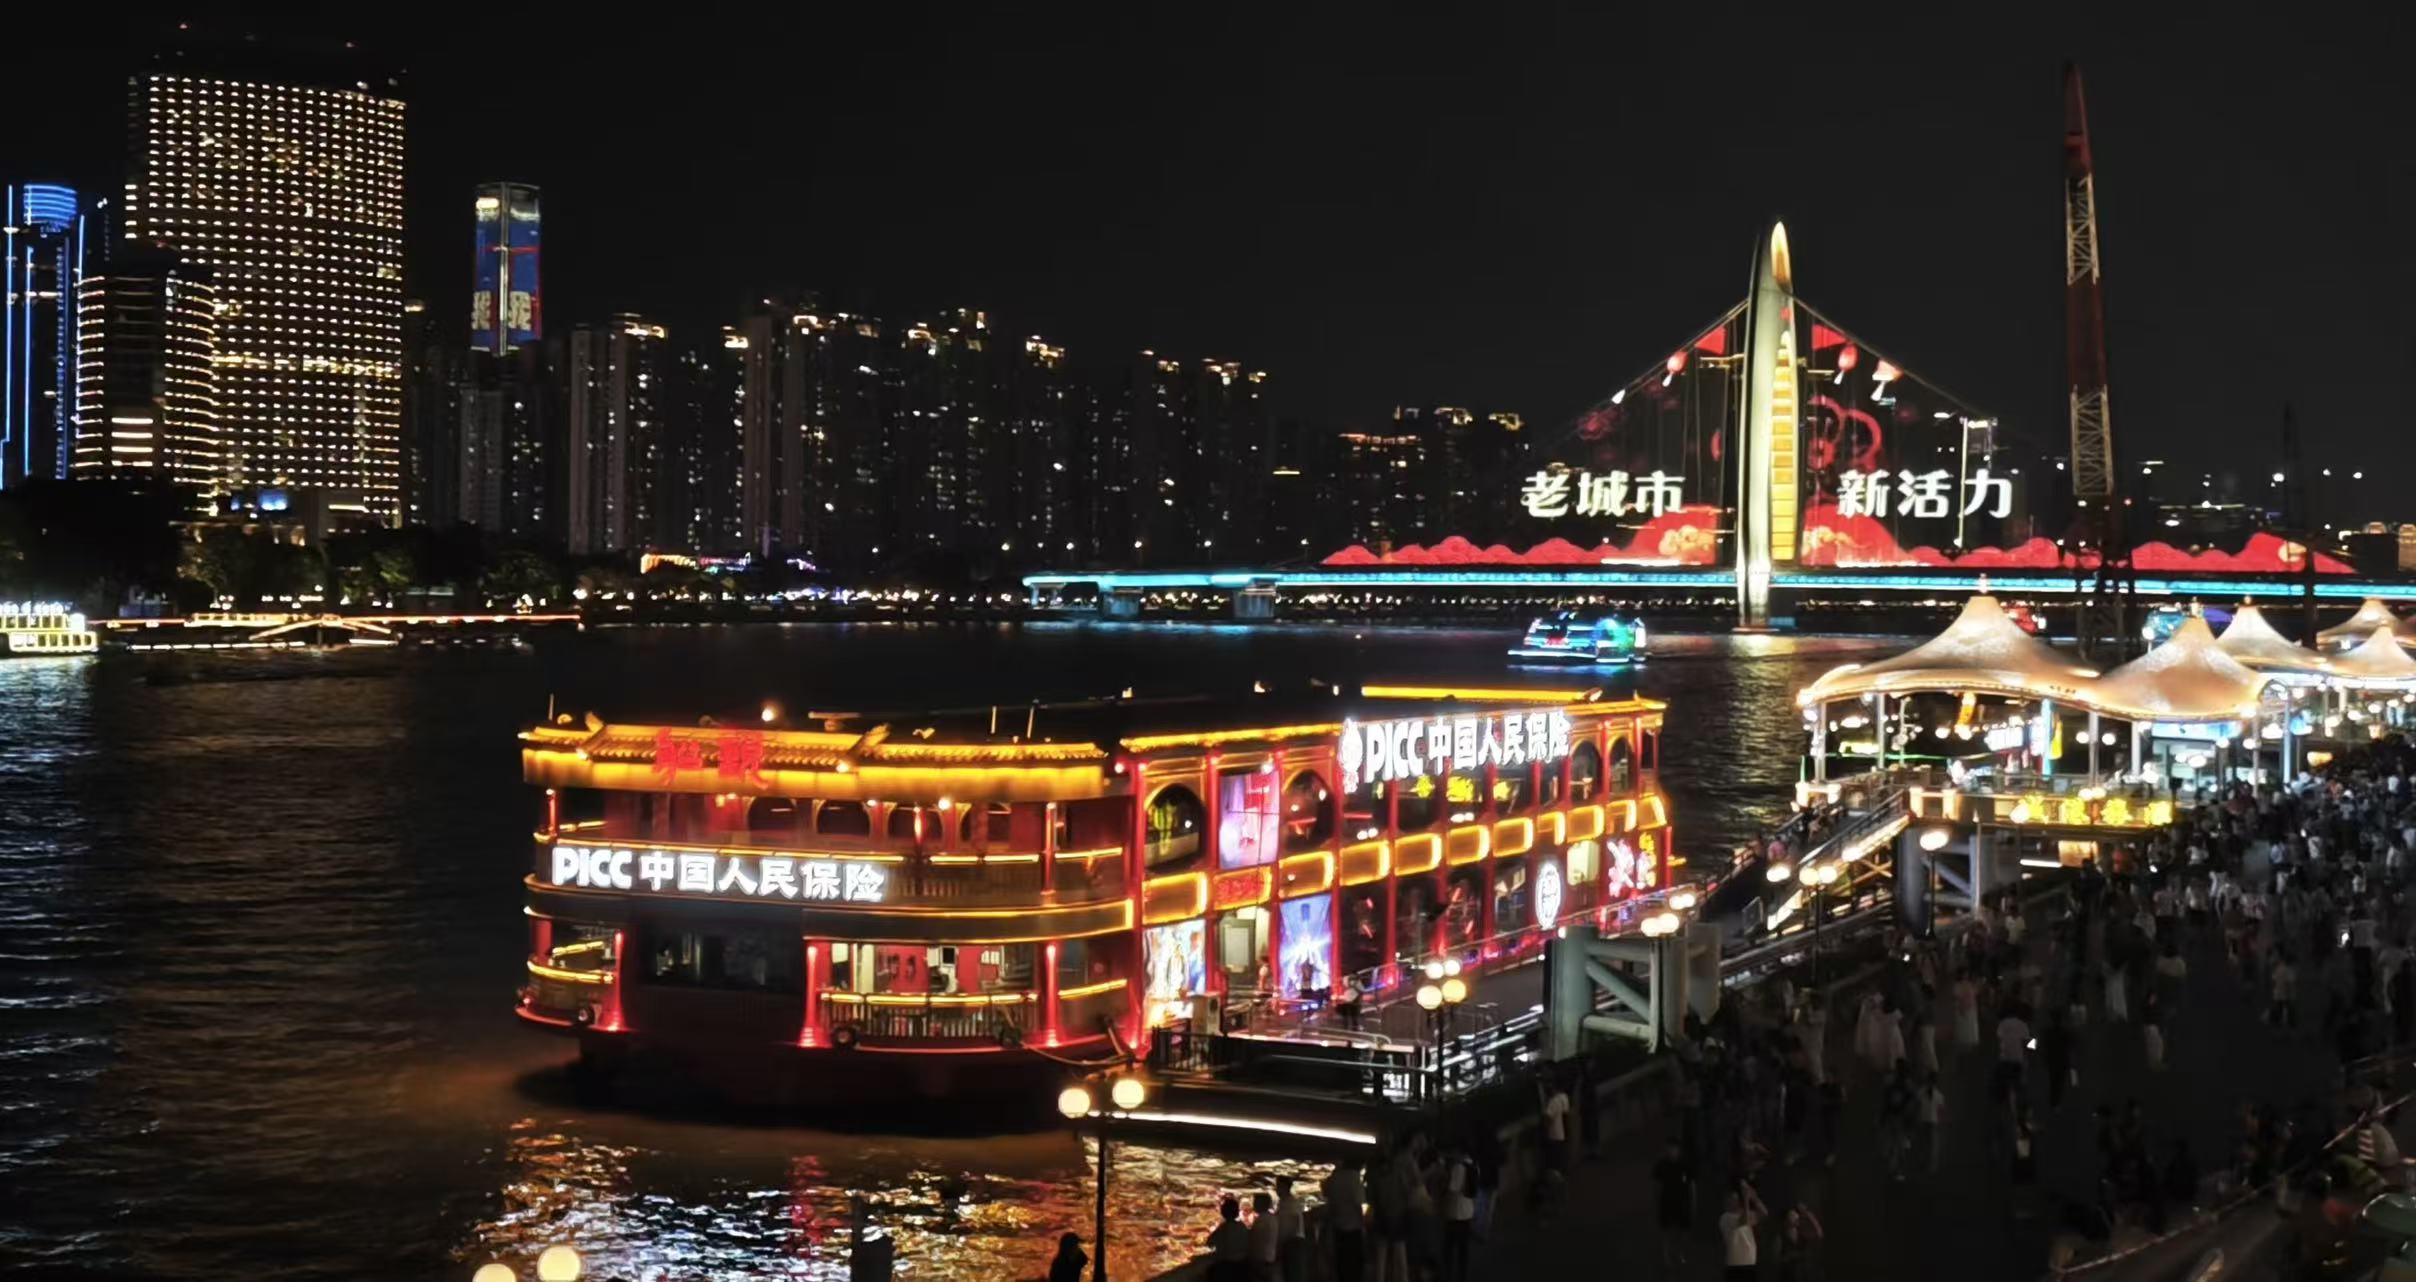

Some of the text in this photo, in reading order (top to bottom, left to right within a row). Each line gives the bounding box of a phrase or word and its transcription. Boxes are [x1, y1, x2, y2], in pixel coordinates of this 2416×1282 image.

[1521, 468, 2013, 518] 老城市 新活力
[1364, 719, 1425, 783] PICC
[1429, 709, 1572, 776] 中国人民保险
[552, 847, 885, 902] PICC 中国人民保险
